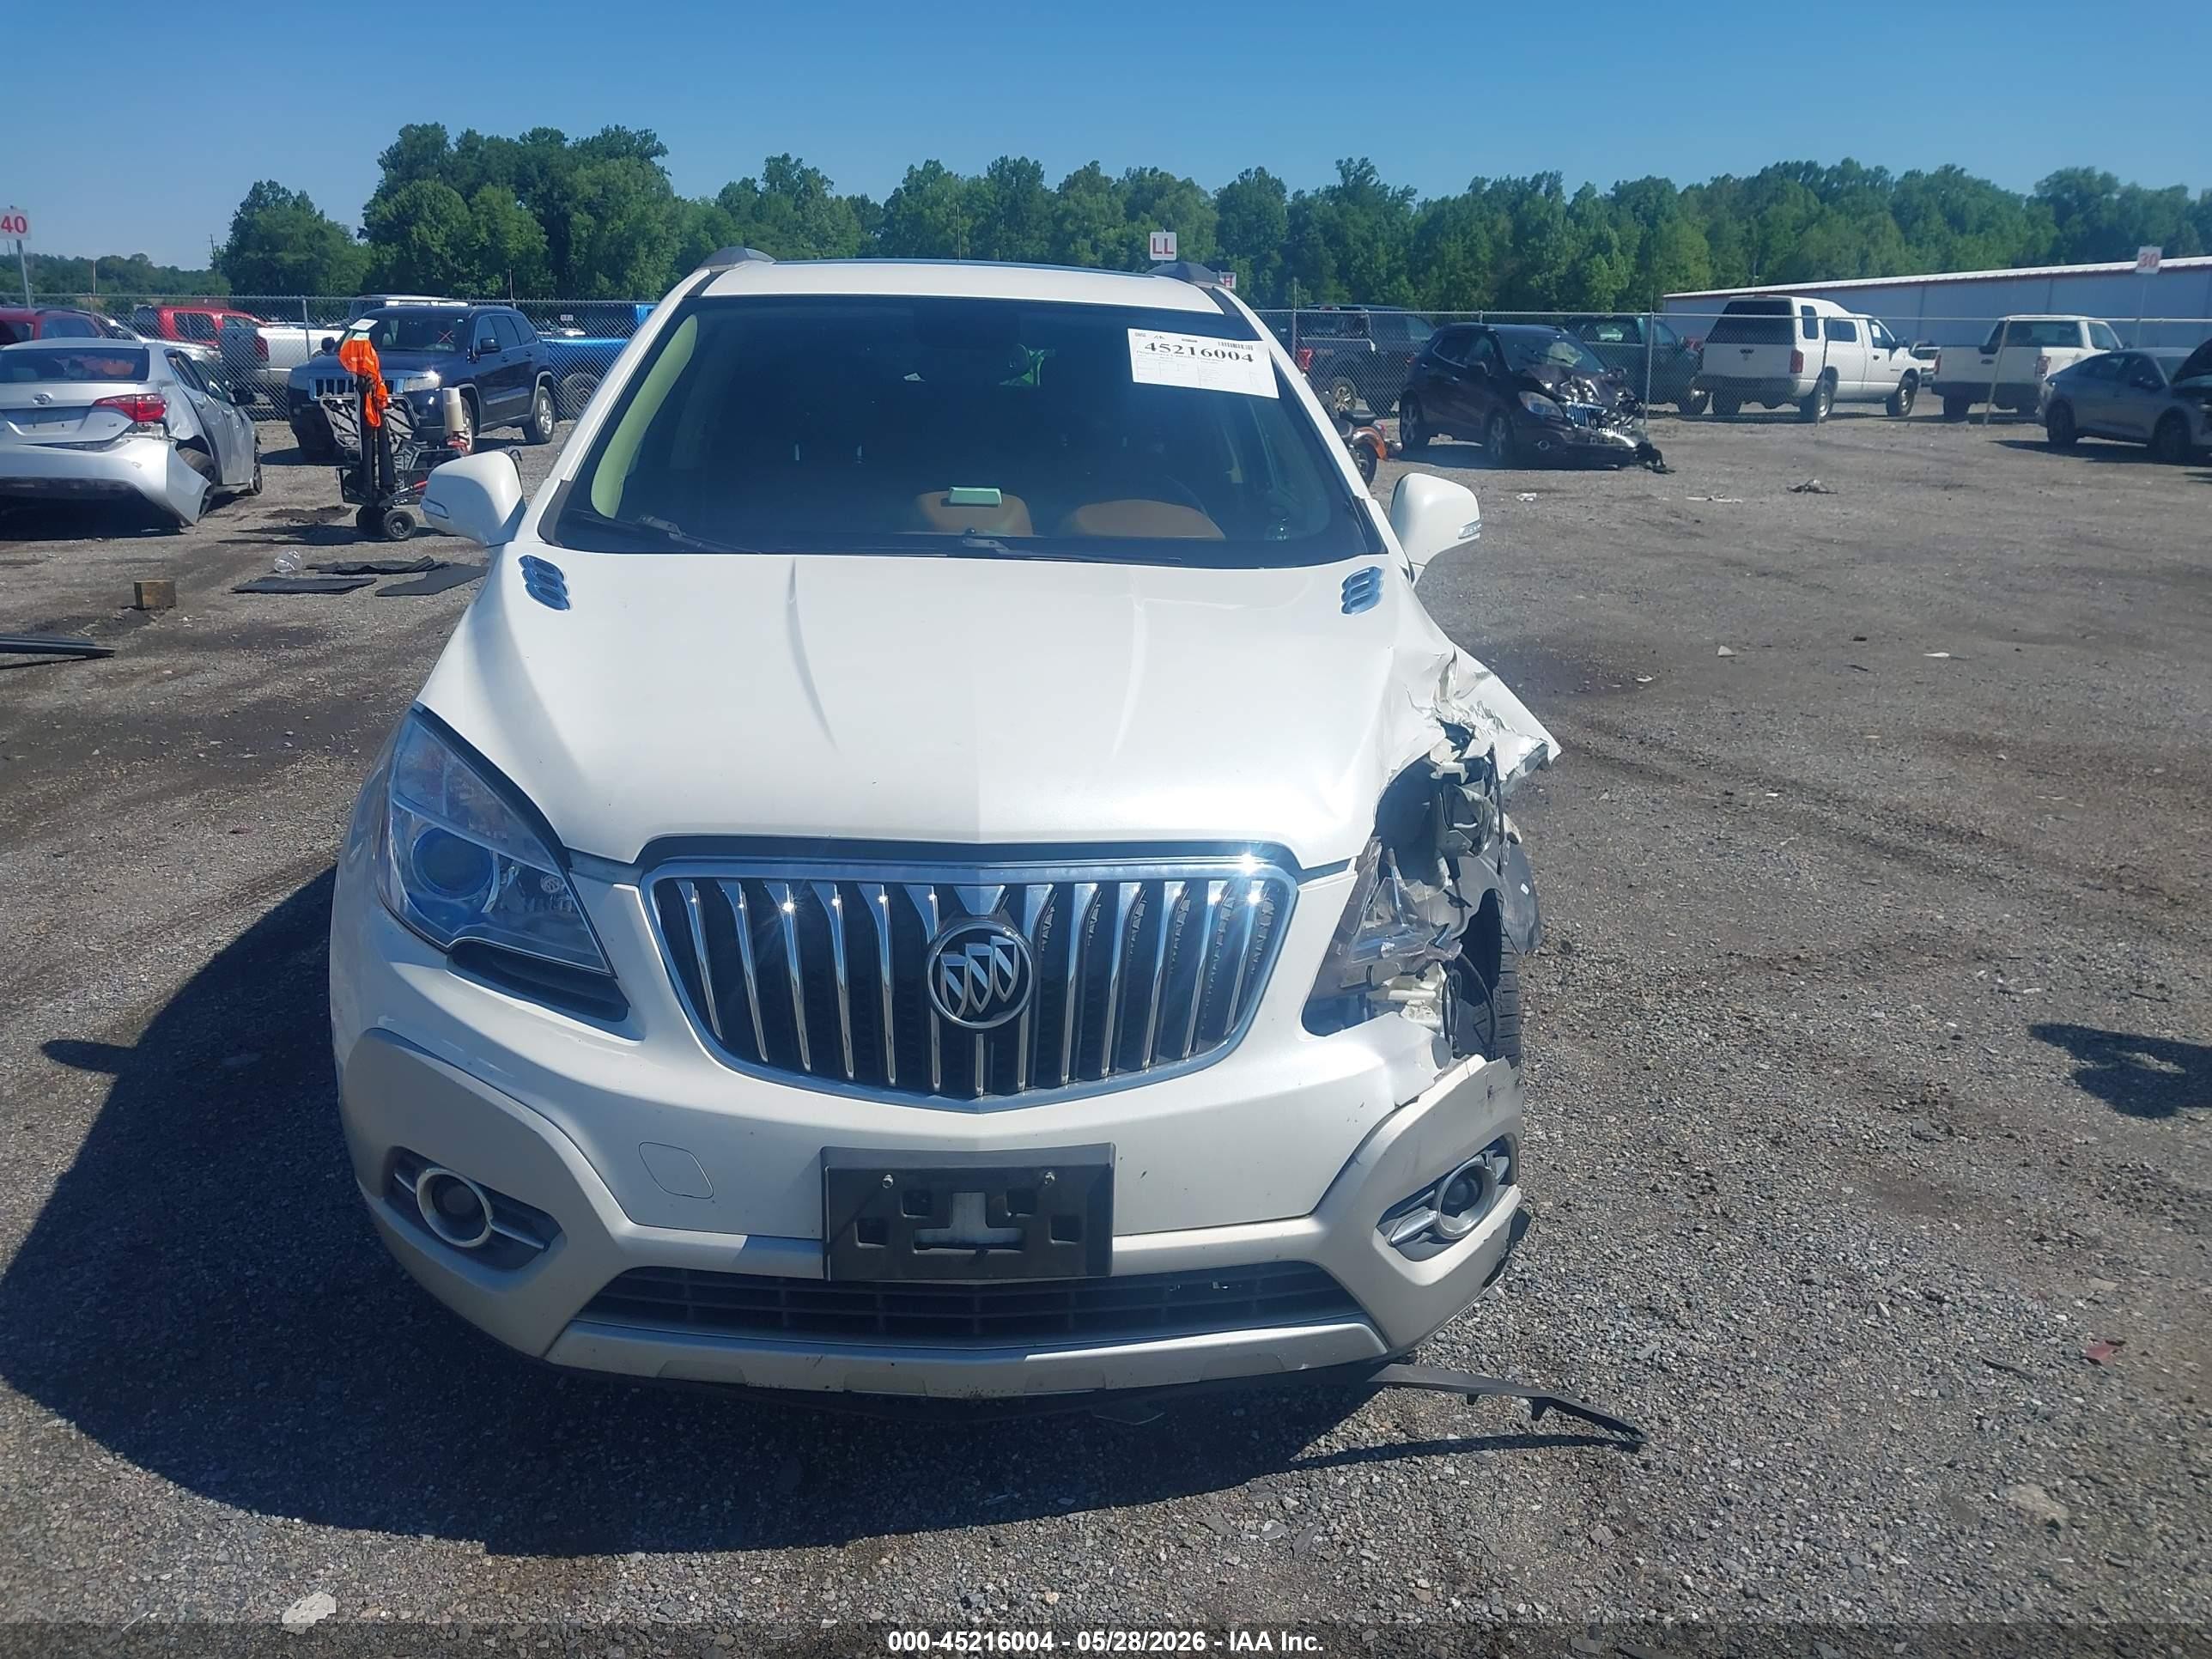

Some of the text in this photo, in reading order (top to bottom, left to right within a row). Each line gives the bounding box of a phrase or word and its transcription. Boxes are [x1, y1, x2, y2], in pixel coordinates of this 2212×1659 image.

[1, 216, 27, 234] 40
[1152, 238, 1175, 255] LL
[1145, 342, 1255, 363] 45216004
